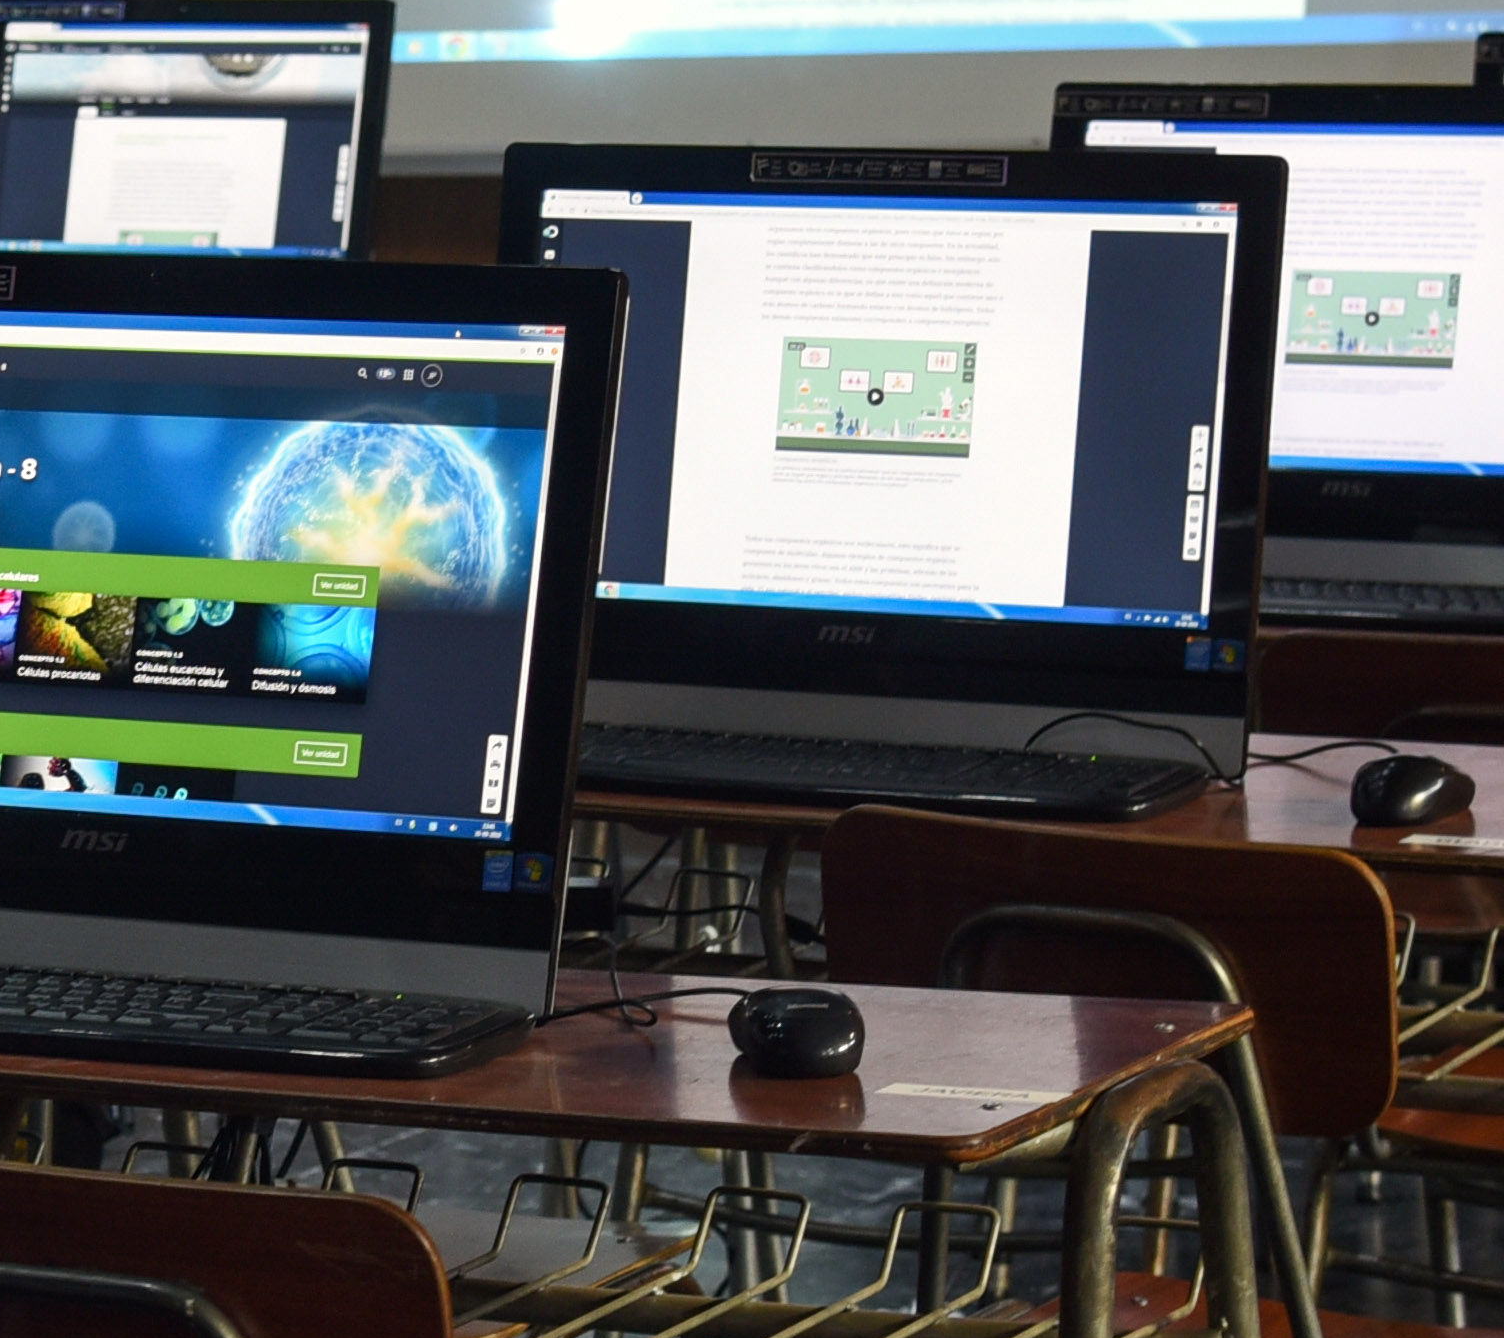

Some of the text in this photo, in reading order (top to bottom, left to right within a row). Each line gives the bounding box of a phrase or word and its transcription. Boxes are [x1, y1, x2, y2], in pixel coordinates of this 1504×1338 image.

[20, 458, 37, 480] 8
[320, 580, 359, 590] Ver unidad
[817, 623, 876, 645] msi
[19, 654, 53, 663] CONCEPTO
[136, 649, 171, 658] CONCEPTO
[17, 665, 101, 682] Células procariotas
[135, 661, 168, 674] Células
[169, 663, 216, 676] eucariotas
[253, 667, 288, 676] CONCEPTO
[133, 672, 229, 689] diferenciación celular
[251, 679, 336, 695] Difusión y ósmosis
[302, 748, 340, 759] Ver unidad
[61, 829, 129, 853] msi
[918, 1085, 1029, 1099] JAVIERA
